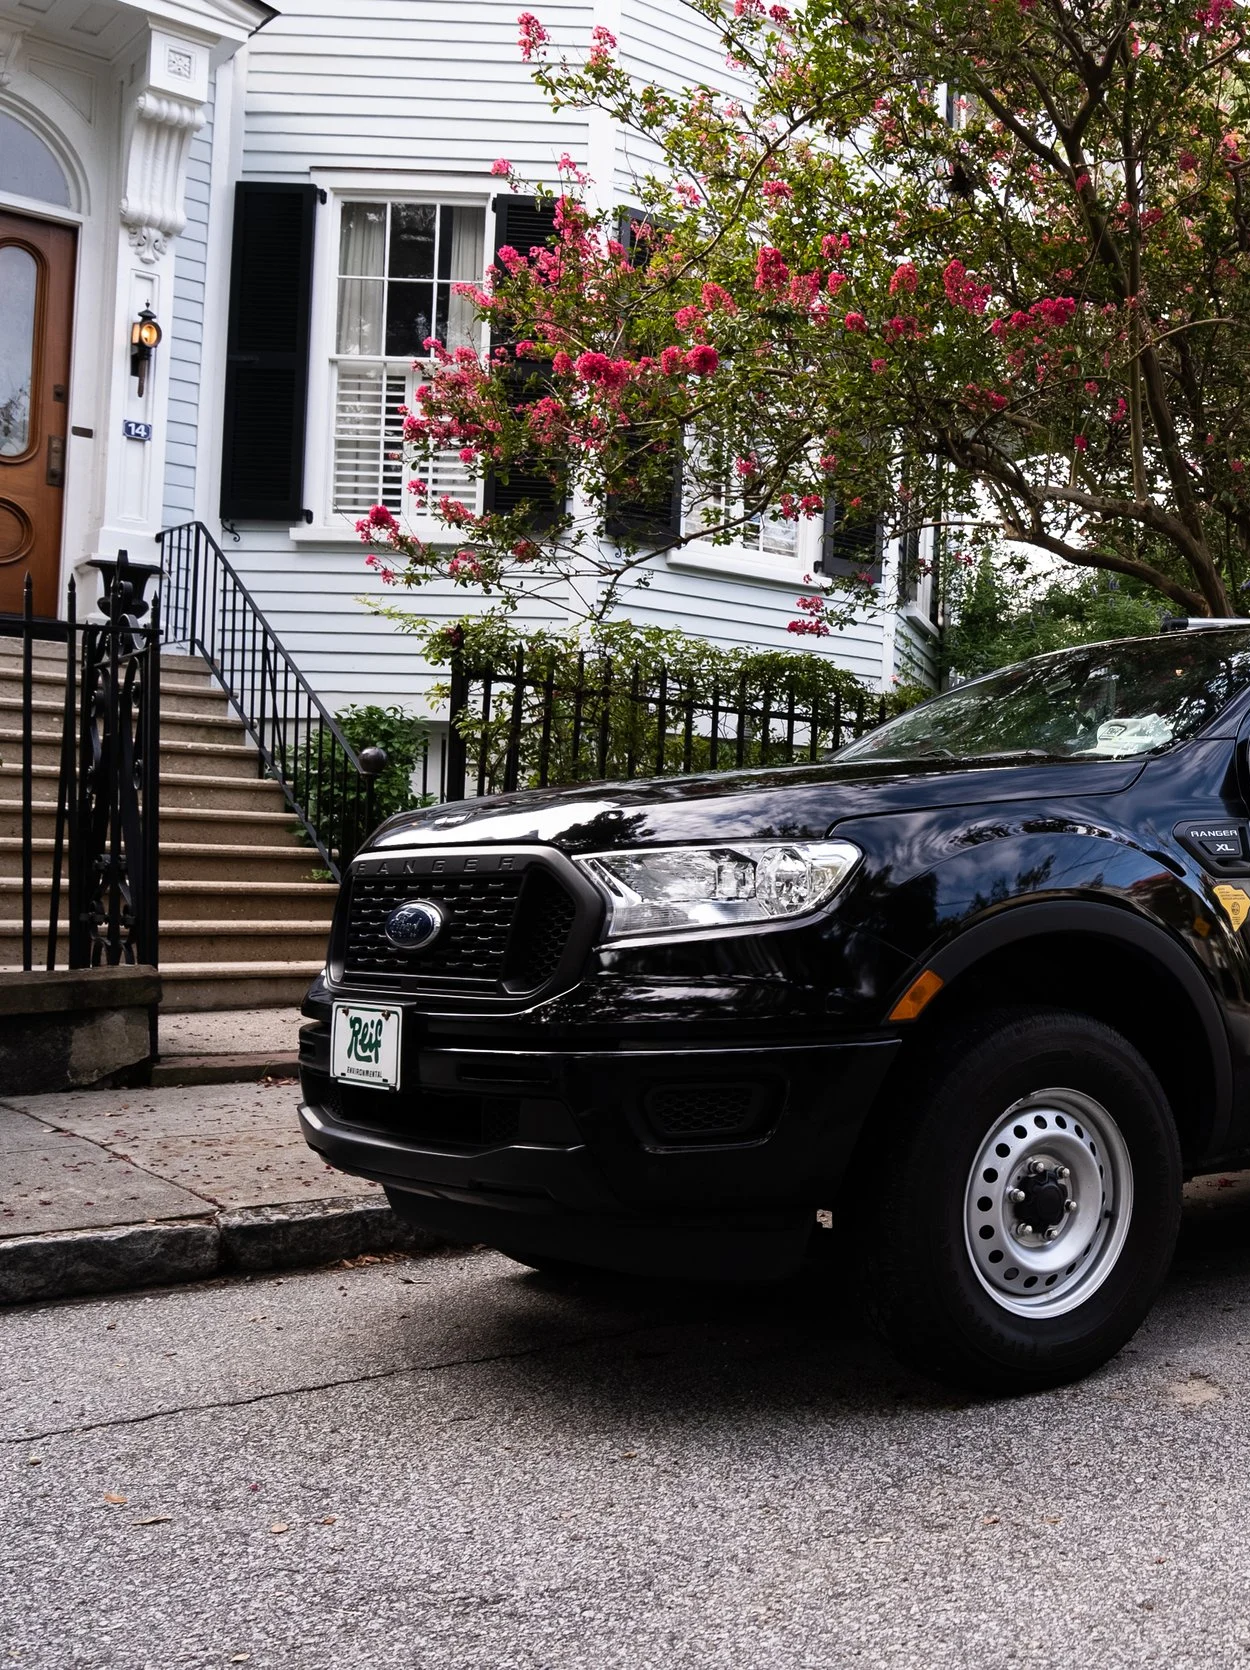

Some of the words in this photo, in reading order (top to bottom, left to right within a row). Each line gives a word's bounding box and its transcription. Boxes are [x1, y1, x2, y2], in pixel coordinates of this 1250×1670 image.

[128, 423, 147, 437] 14
[356, 856, 514, 875] RANGER
[347, 1016, 383, 1064] Reif
